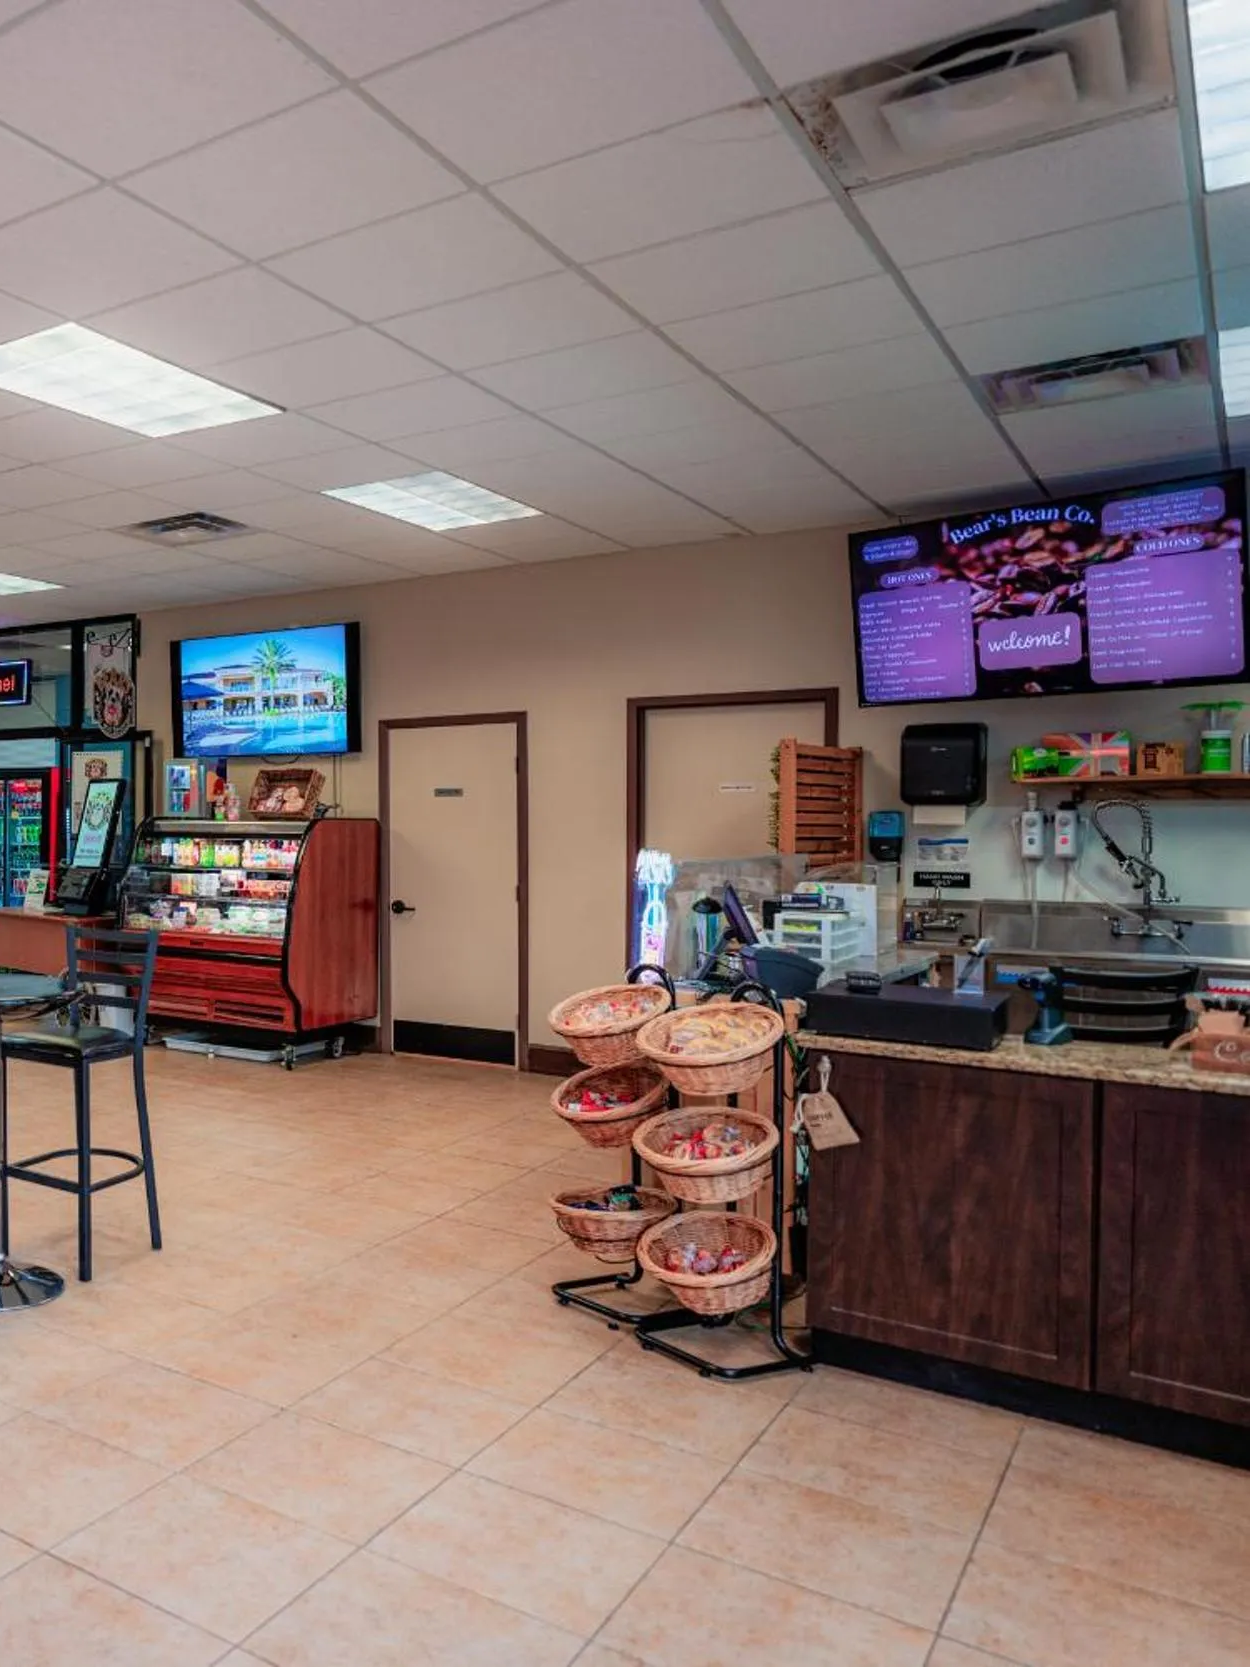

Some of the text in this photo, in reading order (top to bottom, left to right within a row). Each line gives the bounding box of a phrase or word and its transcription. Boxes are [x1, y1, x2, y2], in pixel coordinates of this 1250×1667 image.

[950, 513, 1007, 544] Bear's
[1010, 507, 1060, 524] Bean
[1064, 504, 1095, 524] Co.
[988, 624, 1071, 652] welcome!
